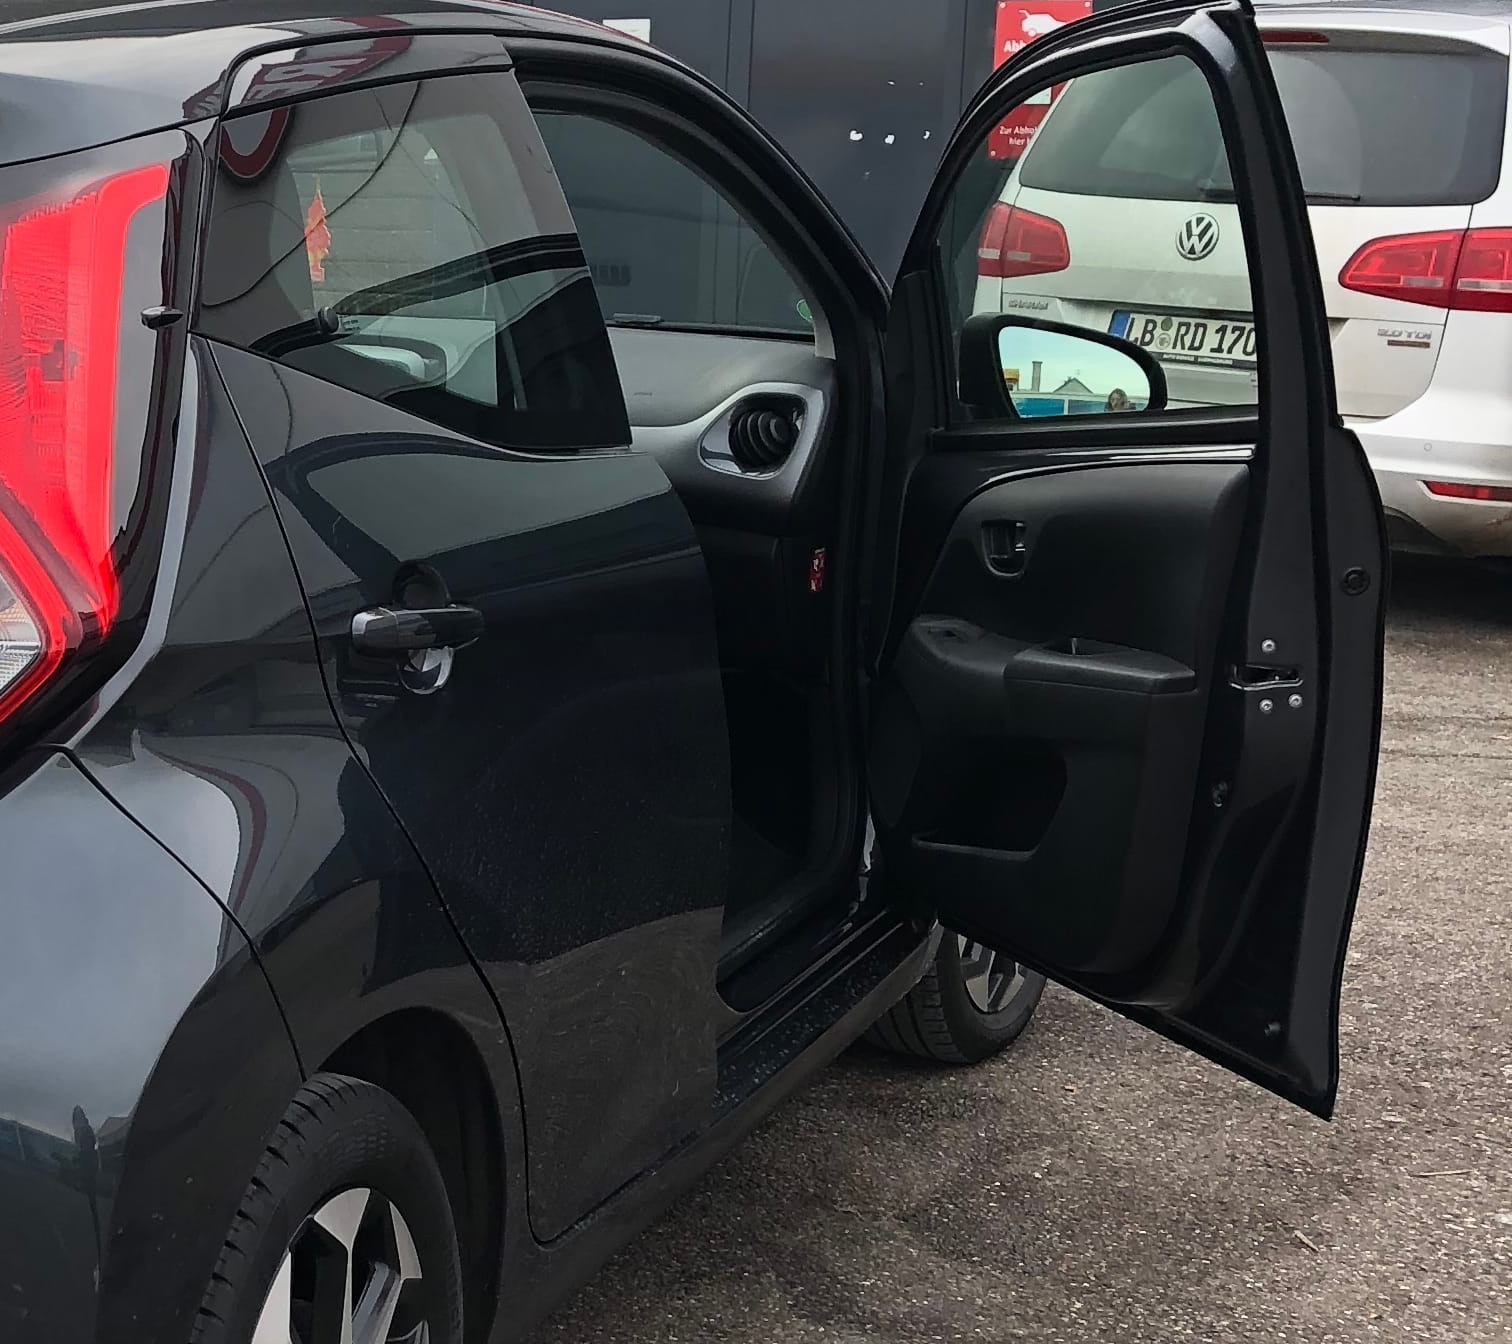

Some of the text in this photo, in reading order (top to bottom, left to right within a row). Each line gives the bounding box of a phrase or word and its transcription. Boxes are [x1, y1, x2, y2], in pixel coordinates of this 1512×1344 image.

[1126, 317, 1256, 357] LB RD 170
